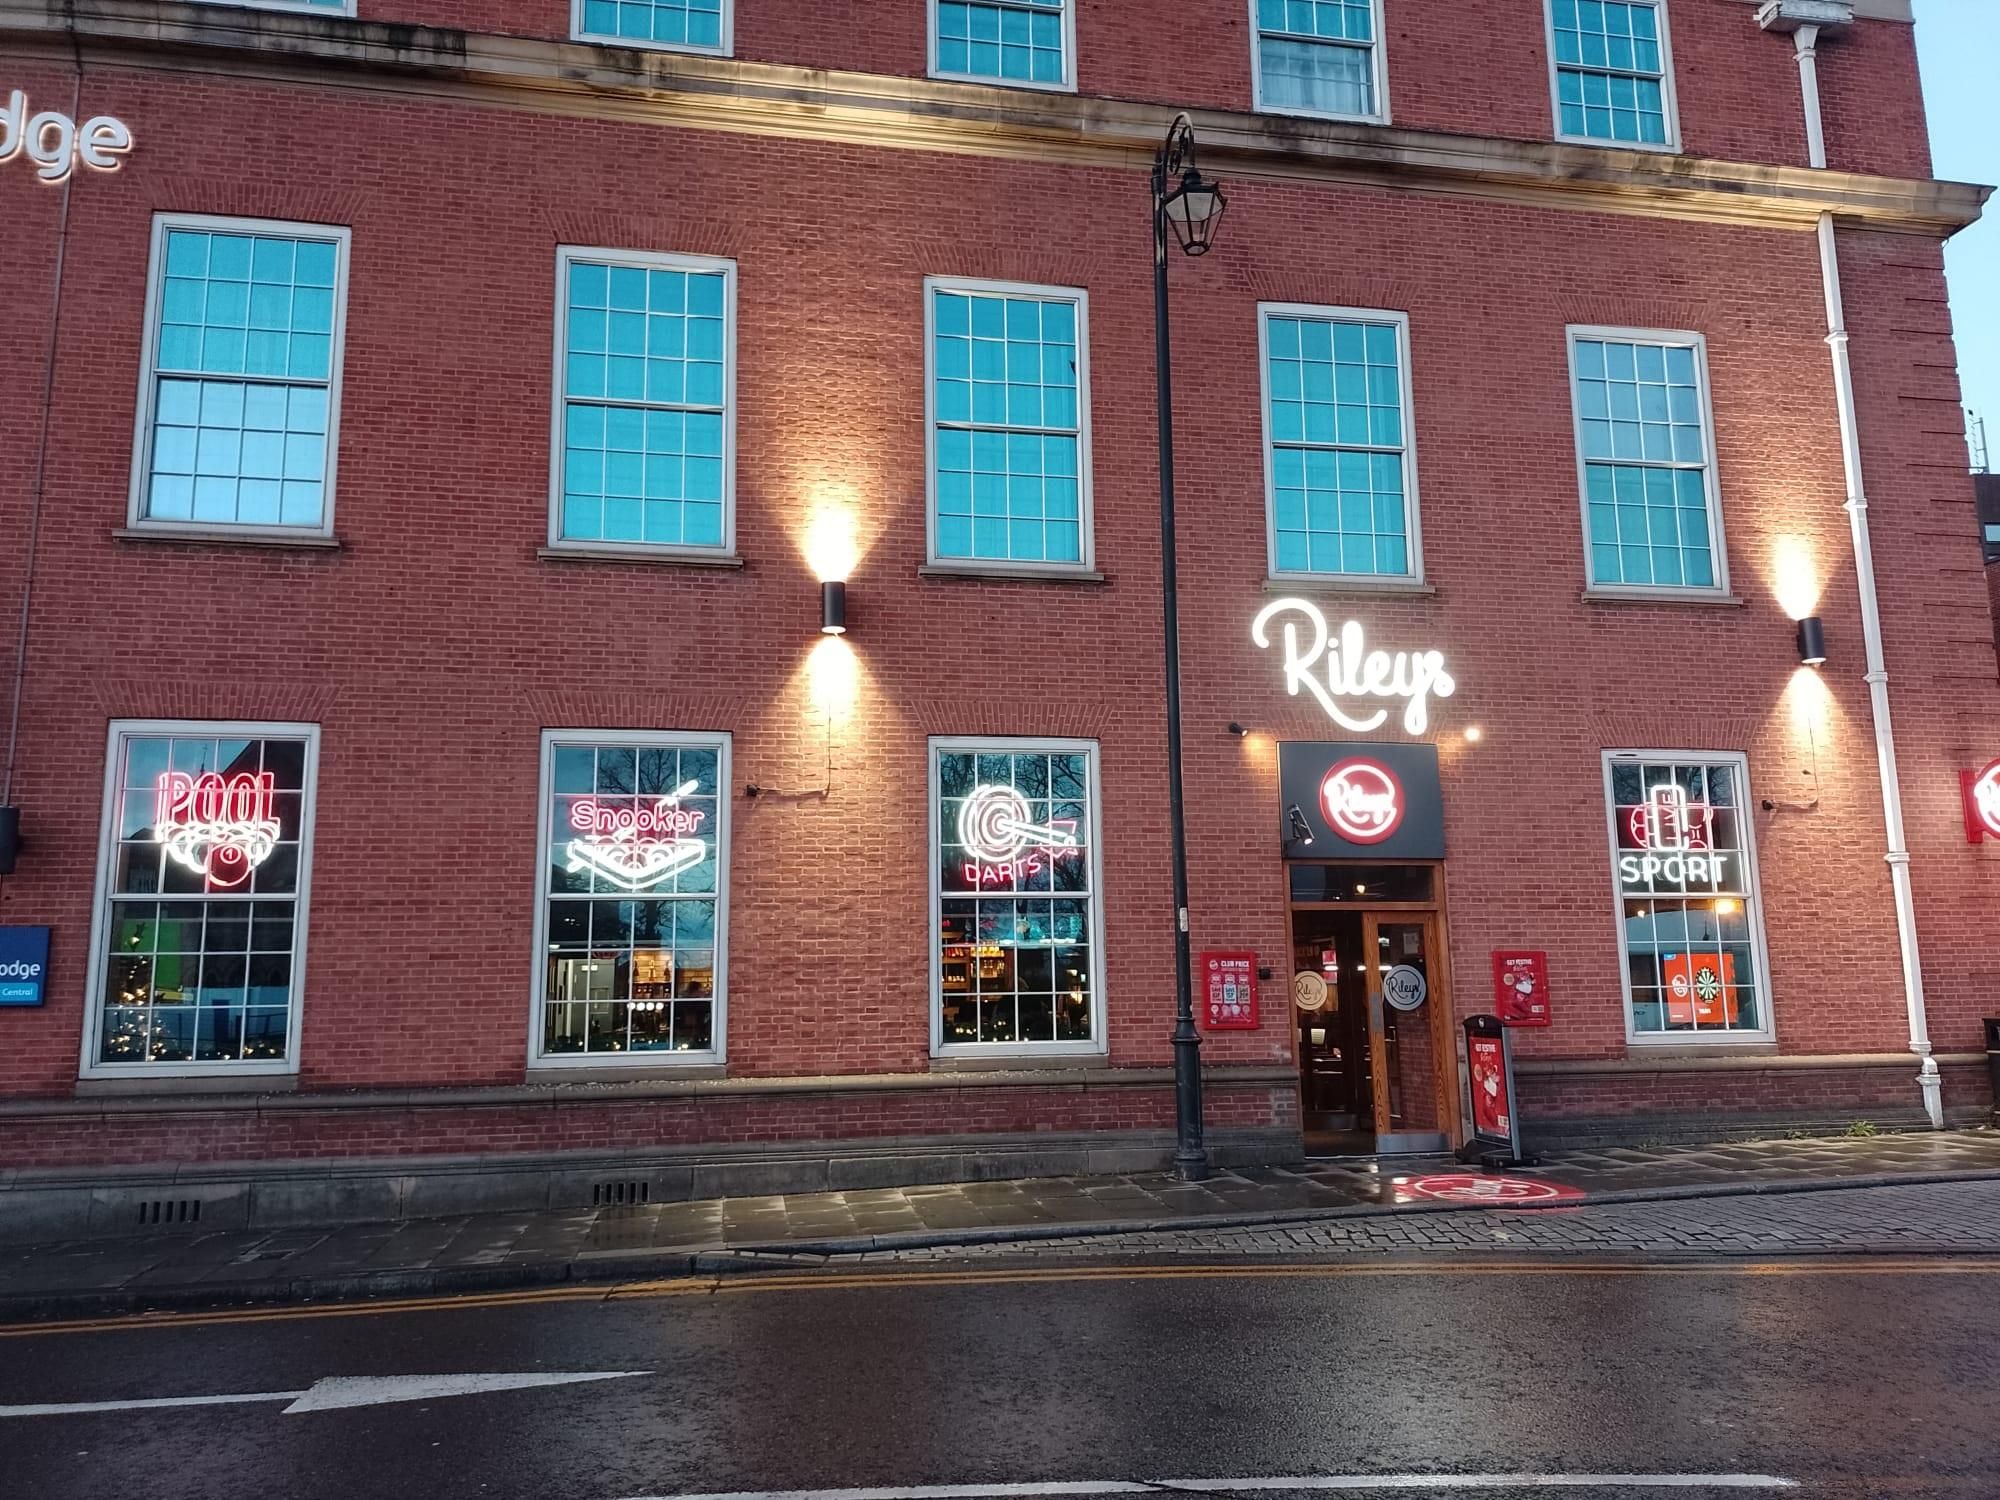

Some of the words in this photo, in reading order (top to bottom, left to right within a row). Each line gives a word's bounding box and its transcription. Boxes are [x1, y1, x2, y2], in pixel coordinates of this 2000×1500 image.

[1252, 597, 1456, 735] Rileys
[156, 772, 281, 826] POOL
[571, 800, 705, 832] Snooker
[964, 852, 1042, 884] DARTS
[1620, 855, 1728, 884] SPORT
[2, 987, 33, 996] Central
[1386, 976, 1420, 1000] Rileys
